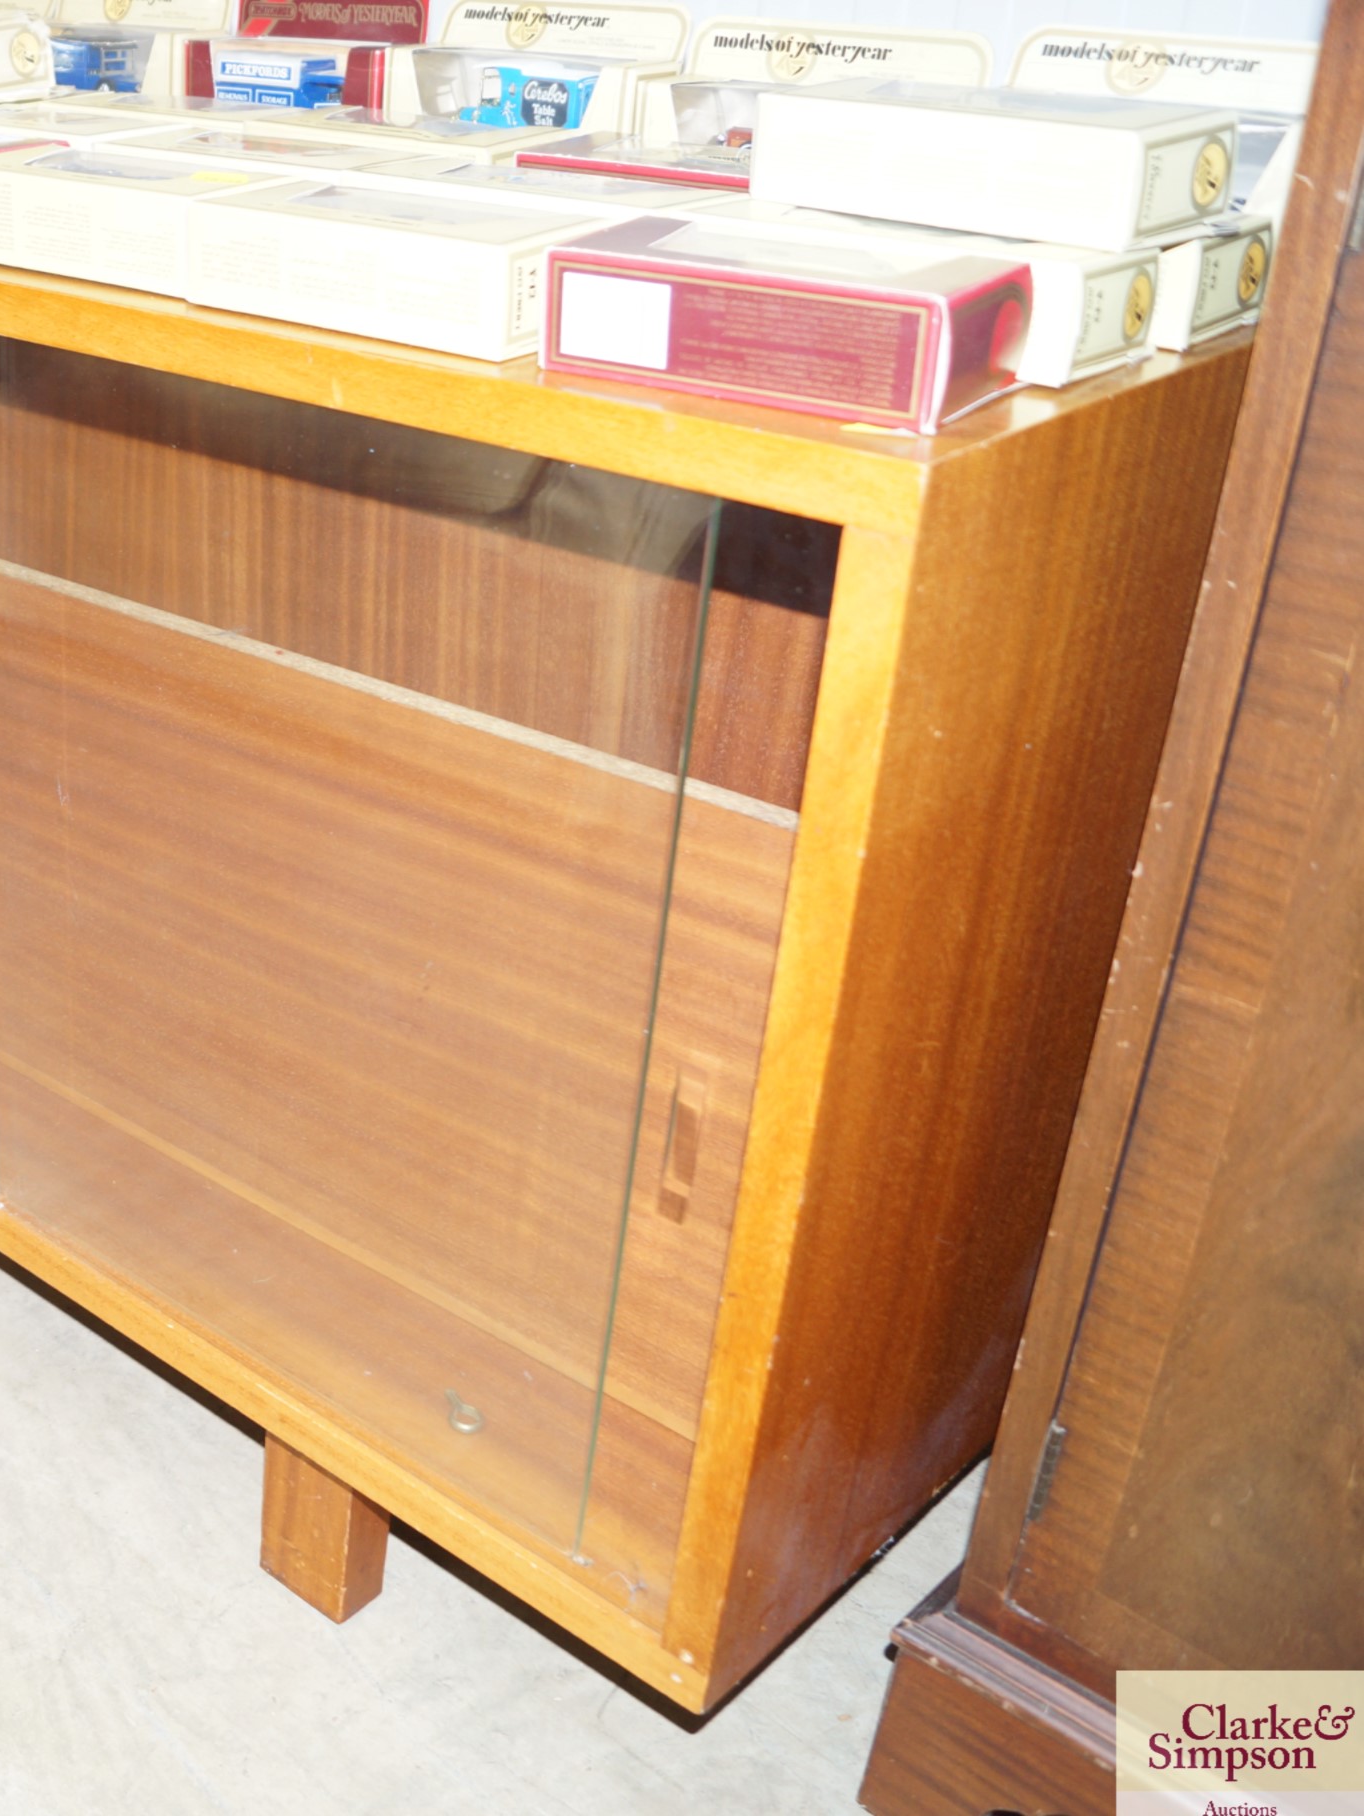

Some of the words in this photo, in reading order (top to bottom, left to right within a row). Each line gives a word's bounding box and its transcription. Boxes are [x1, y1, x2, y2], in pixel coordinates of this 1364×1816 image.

[349, 4, 417, 26] YESTERYEAR
[464, 6, 513, 24] models
[525, 10, 611, 31] yesteryear
[713, 32, 773, 52] models
[774, 36, 794, 53] of
[789, 40, 893, 64] yesteryear
[1040, 41, 1114, 61] models
[1116, 45, 1141, 63] of
[1134, 50, 1262, 75] yesteryear
[224, 63, 289, 79] PICKFORDS
[523, 80, 568, 104] Cerebos
[532, 103, 556, 117] Table
[533, 115, 554, 127] Salt
